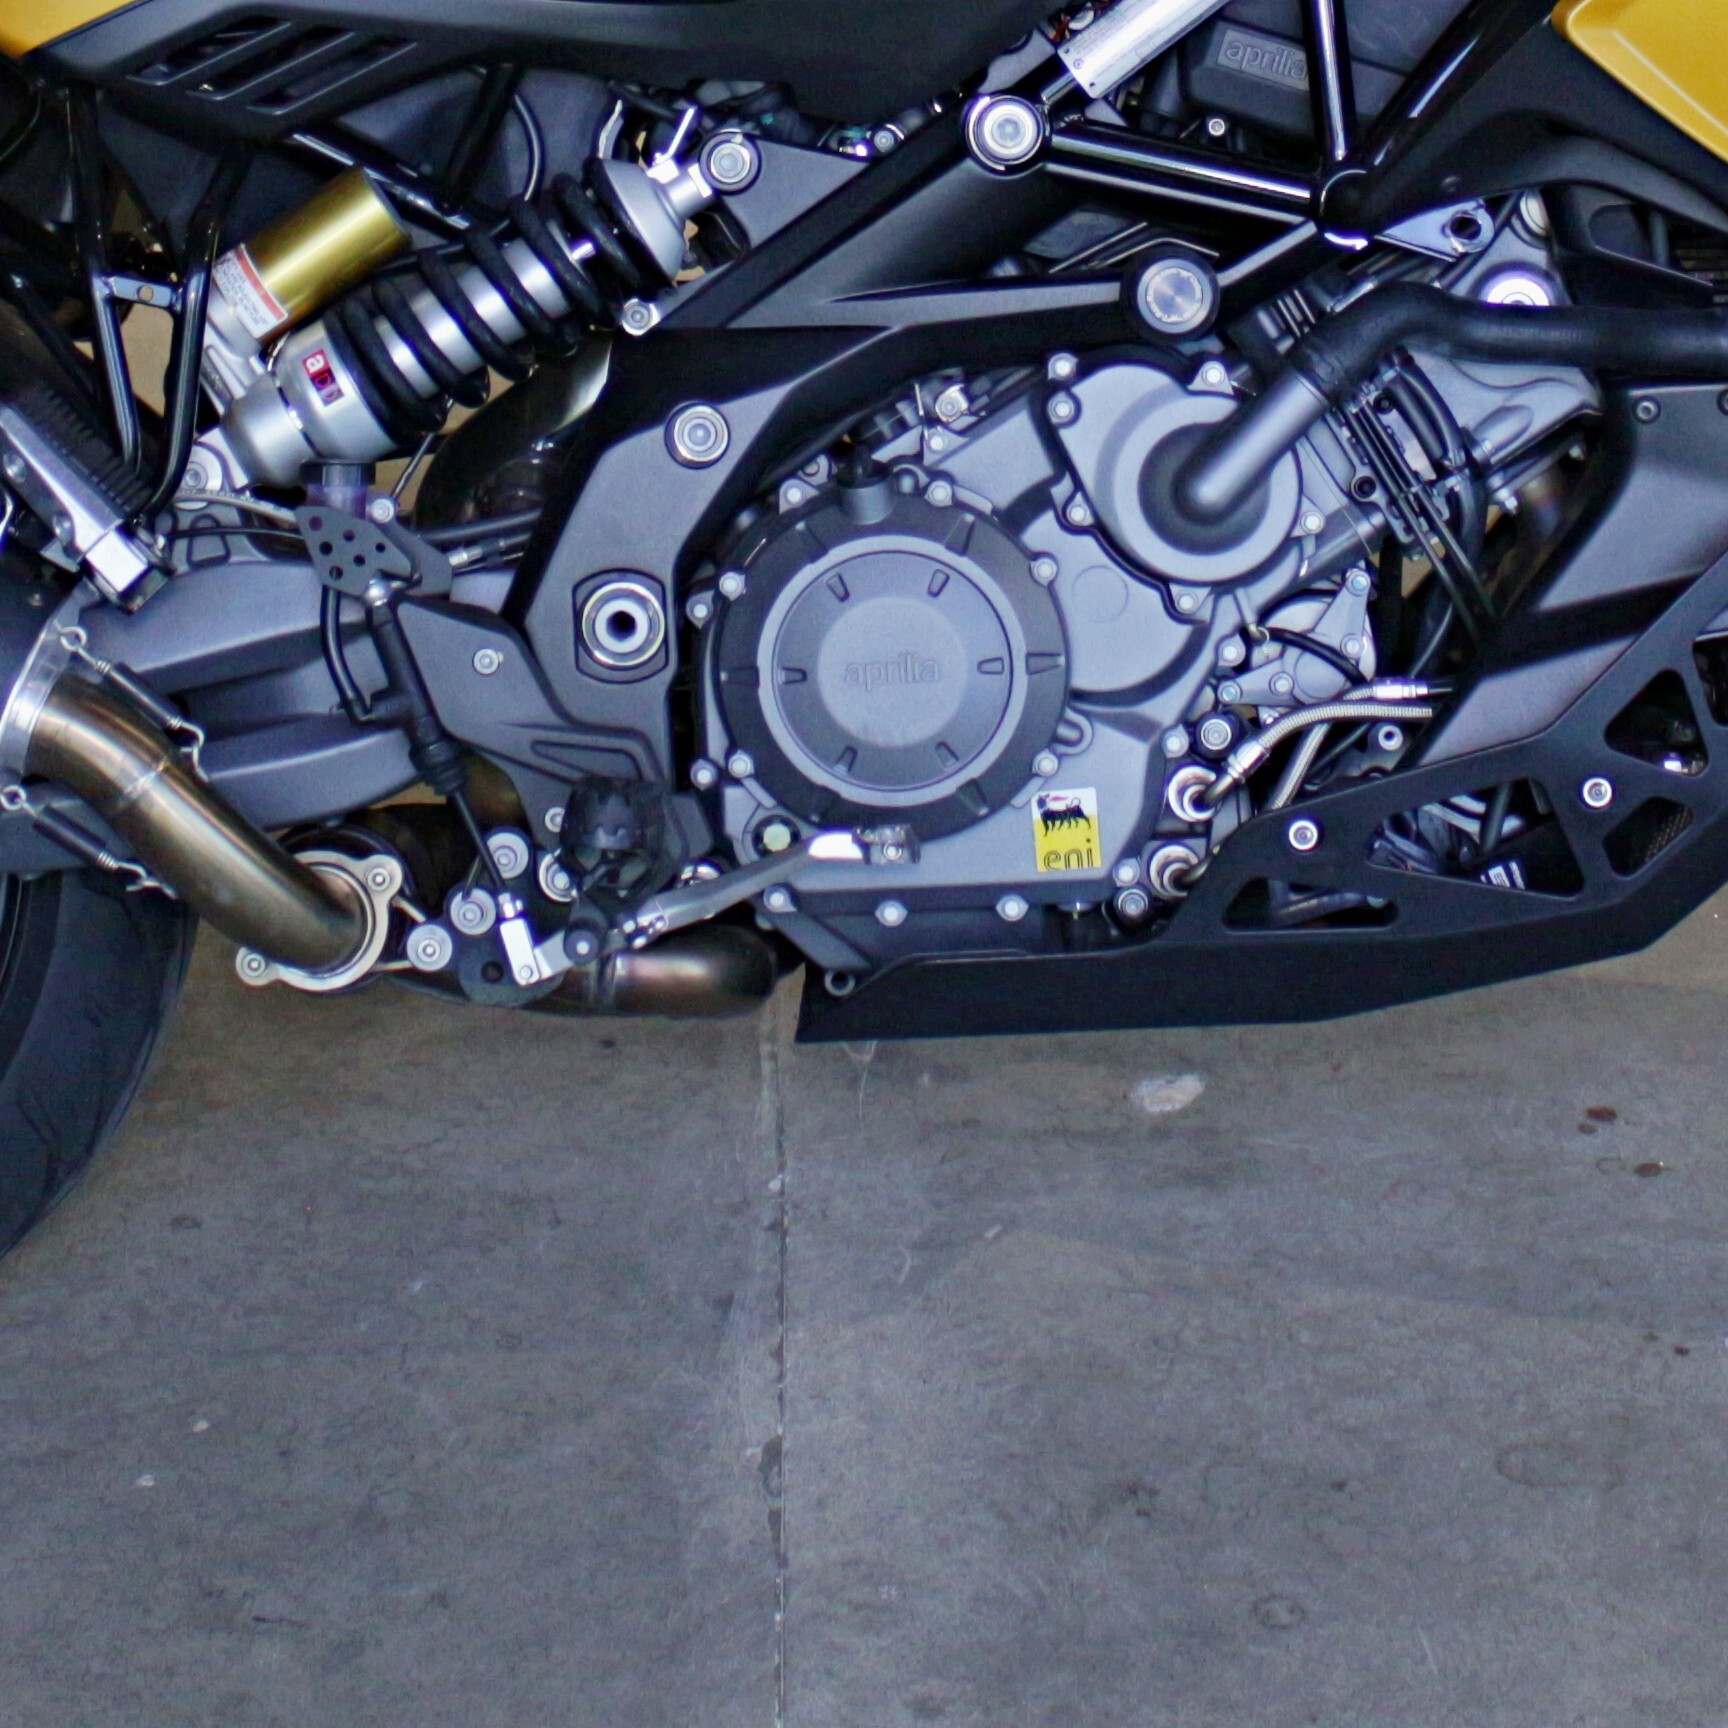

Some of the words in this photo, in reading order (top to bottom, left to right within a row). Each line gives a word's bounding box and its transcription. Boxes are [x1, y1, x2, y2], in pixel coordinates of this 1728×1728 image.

[1226, 41, 1308, 80] aprilia
[844, 652, 940, 692] aprilia
[1043, 837, 1094, 872] eni
